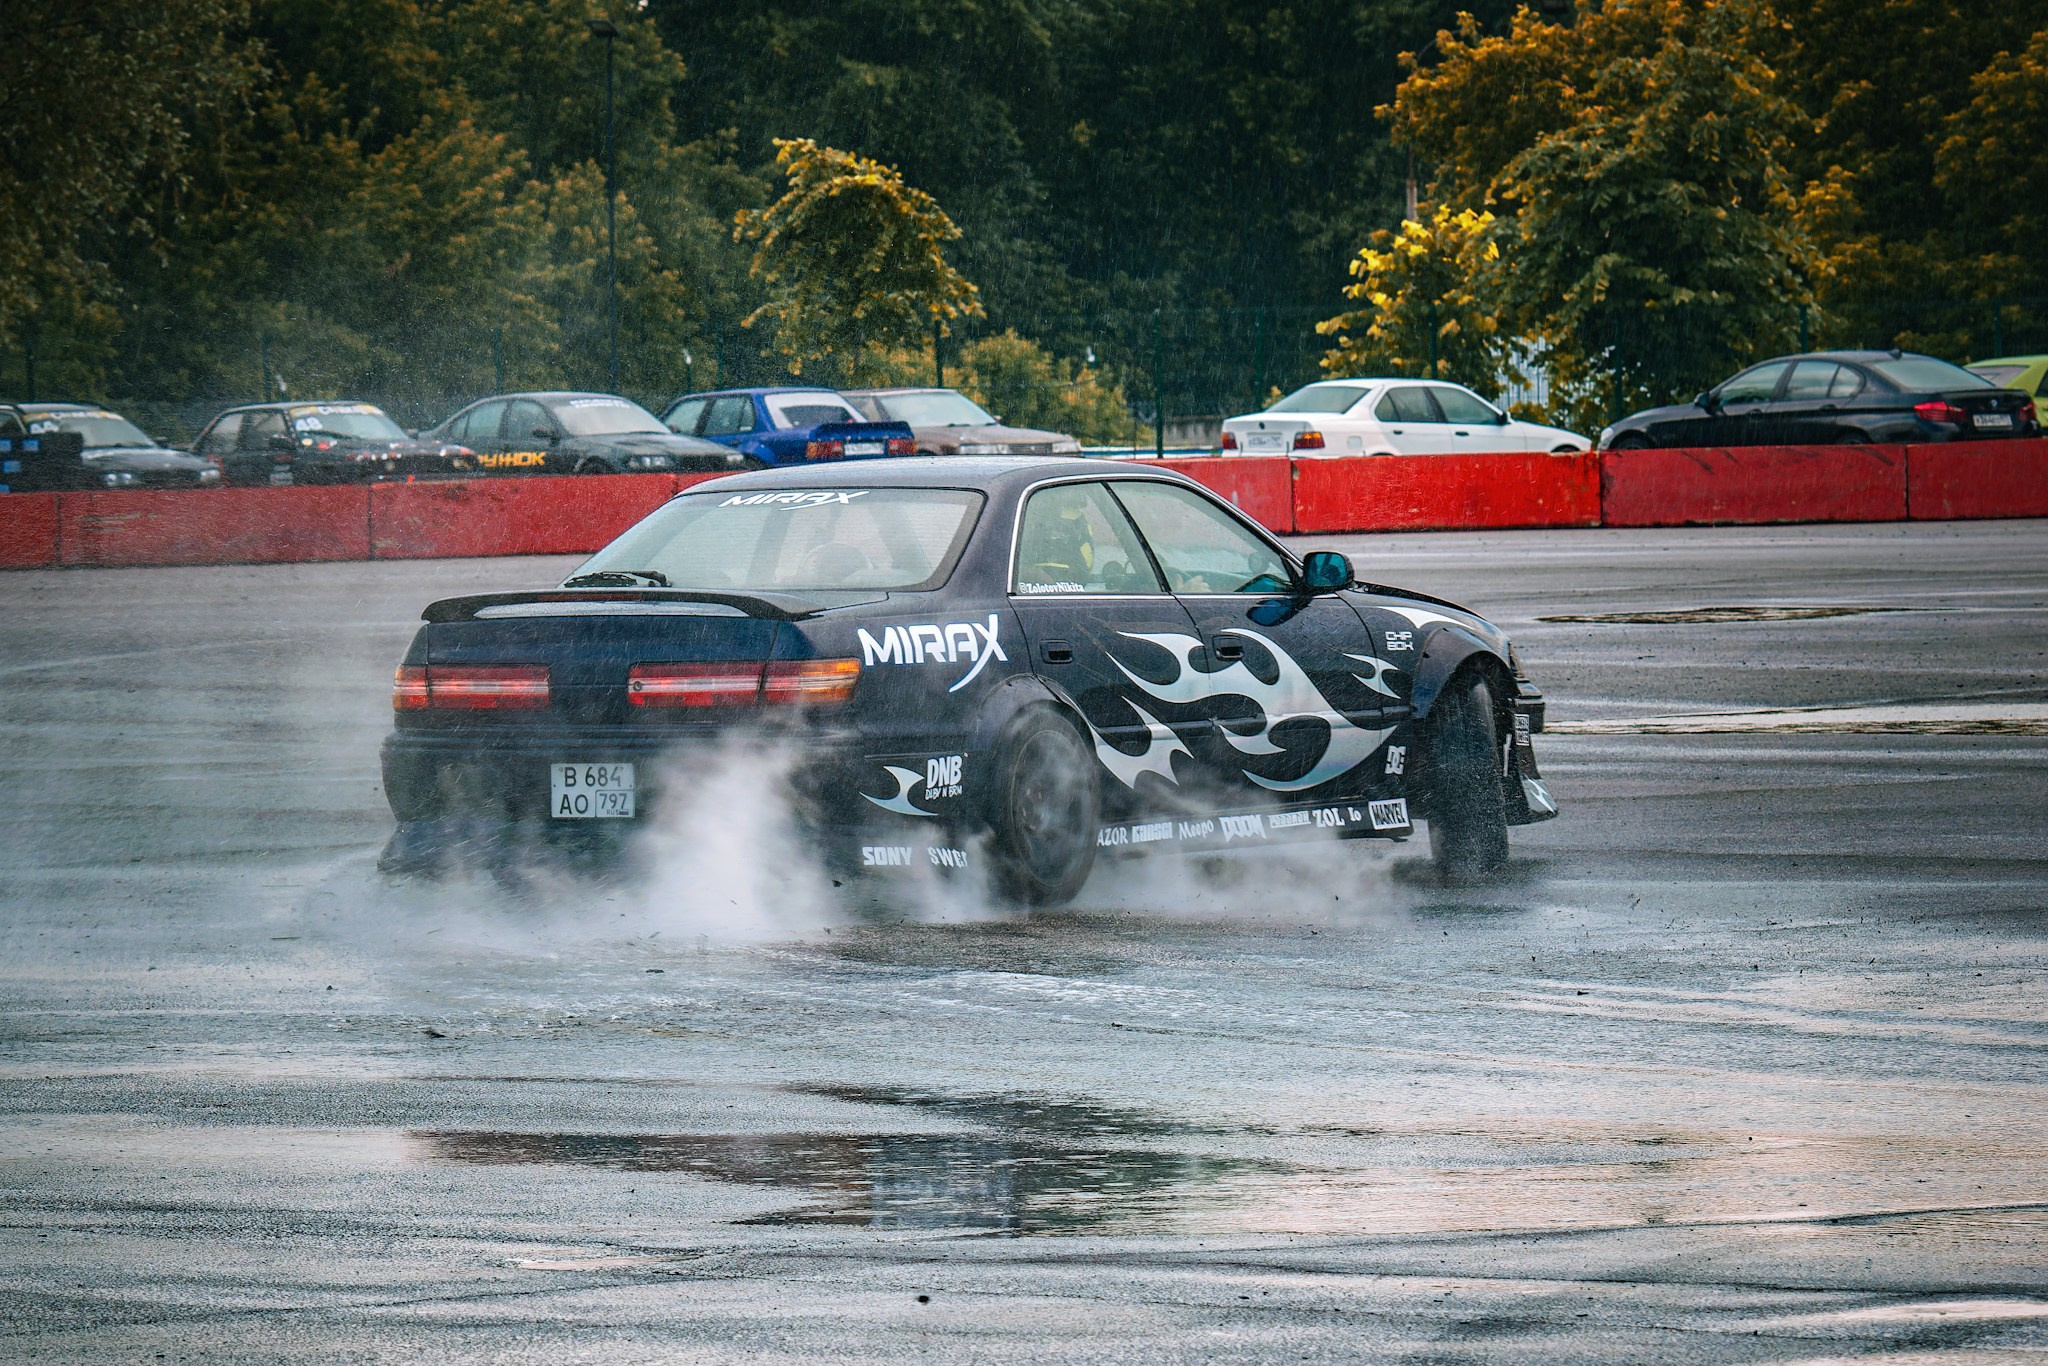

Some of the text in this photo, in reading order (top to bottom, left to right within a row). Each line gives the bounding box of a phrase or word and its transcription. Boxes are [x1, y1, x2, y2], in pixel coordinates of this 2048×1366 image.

[718, 490, 870, 511] MIRAX
[1020, 582, 1085, 594] @ZolotovNikita
[857, 613, 1009, 693] MIRAX
[585, 766, 622, 788] 684
[927, 755, 963, 789] DNB
[599, 793, 627, 809] 797
[1218, 813, 1268, 843] DOOM
[1312, 807, 1346, 828] ZOL
[1096, 826, 1129, 848] AZOR
[862, 846, 913, 866] SONY
